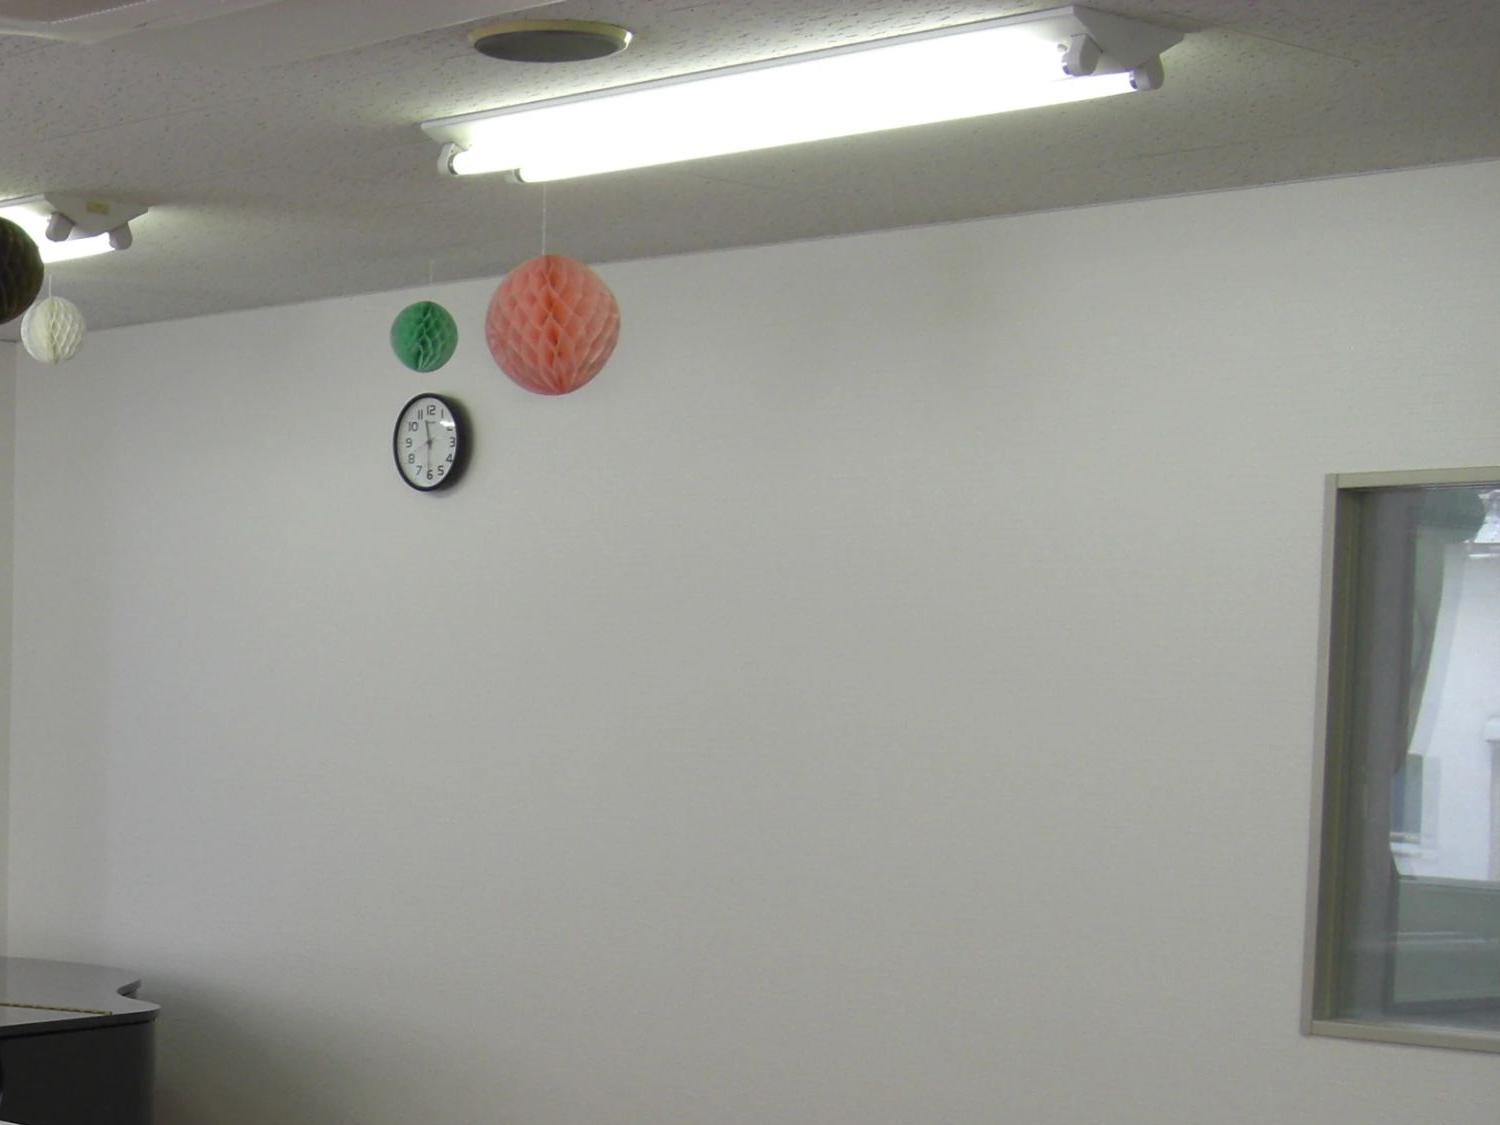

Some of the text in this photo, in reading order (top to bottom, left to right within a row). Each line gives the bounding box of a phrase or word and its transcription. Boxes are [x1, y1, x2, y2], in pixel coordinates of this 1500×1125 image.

[418, 410, 423, 420] 11
[427, 405, 436, 415] 12
[409, 422, 418, 432] 10
[406, 438, 412, 448] 9
[450, 437, 456, 447] 3
[409, 454, 415, 464] 8
[446, 454, 453, 462] 4
[416, 466, 422, 475] 7
[427, 470, 433, 480] 6
[438, 466, 444, 476] 5
